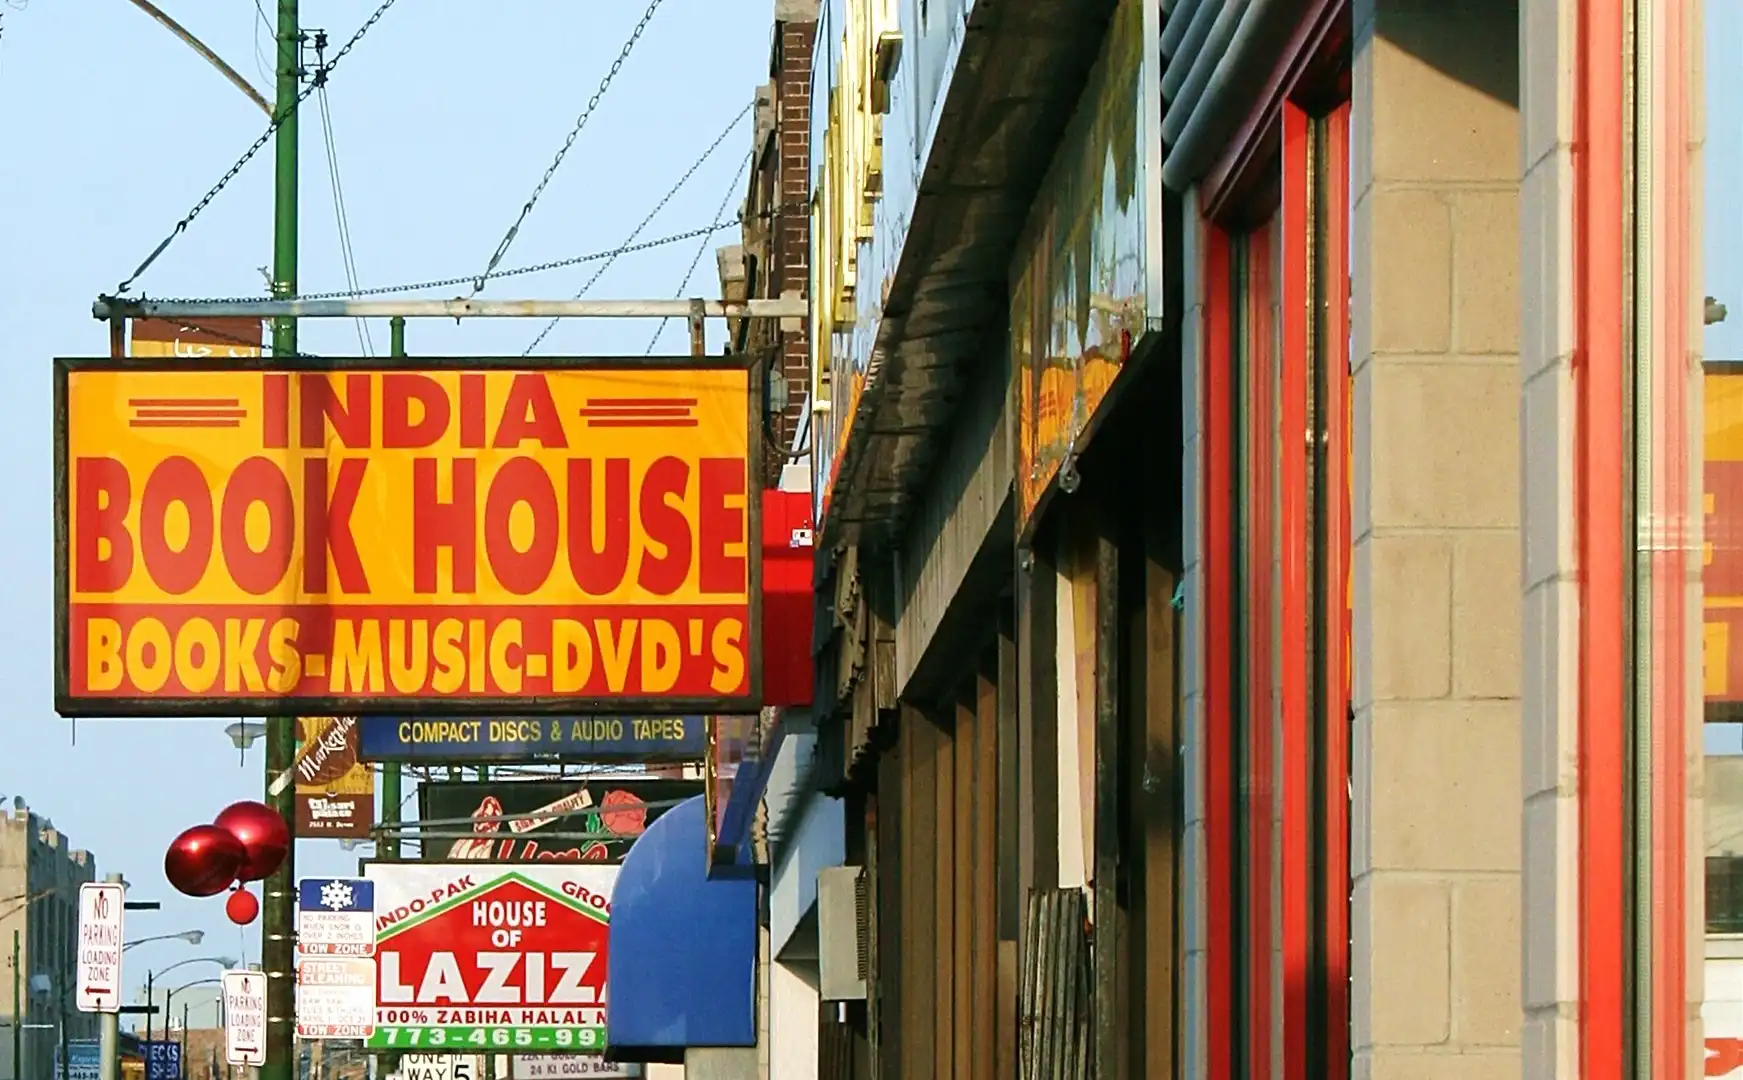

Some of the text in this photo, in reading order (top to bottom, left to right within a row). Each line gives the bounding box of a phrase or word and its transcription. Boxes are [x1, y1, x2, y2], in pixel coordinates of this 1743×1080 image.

[263, 373, 568, 449] INDIA
[76, 455, 746, 596] BOOK HOUSE
[399, 719, 685, 743] COMPACT DISCS & AUDIO TAPES
[94, 898, 109, 920] NO
[376, 874, 475, 931] INDO-PAK
[473, 900, 546, 927] HOUSE
[84, 924, 118, 946] PARKING
[491, 930, 521, 948] OF
[303, 944, 366, 955] TOW ZONE
[82, 950, 117, 966] LOADING
[88, 966, 110, 982] ZONE
[381, 952, 608, 1003] LAZIZ
[241, 978, 251, 994] NO
[230, 995, 262, 1011] PARKING
[231, 1012, 261, 1028] LOADING
[377, 1009, 427, 1024] 100%
[437, 1010, 513, 1025] ZABIHA
[522, 1010, 587, 1025] HALAL
[237, 1028, 255, 1042] ZONE
[303, 1025, 366, 1036] TOW ZONE
[383, 1027, 604, 1046] 773-465-99
[408, 1067, 447, 1080] WAY
[562, 1063, 589, 1074] GOLD
